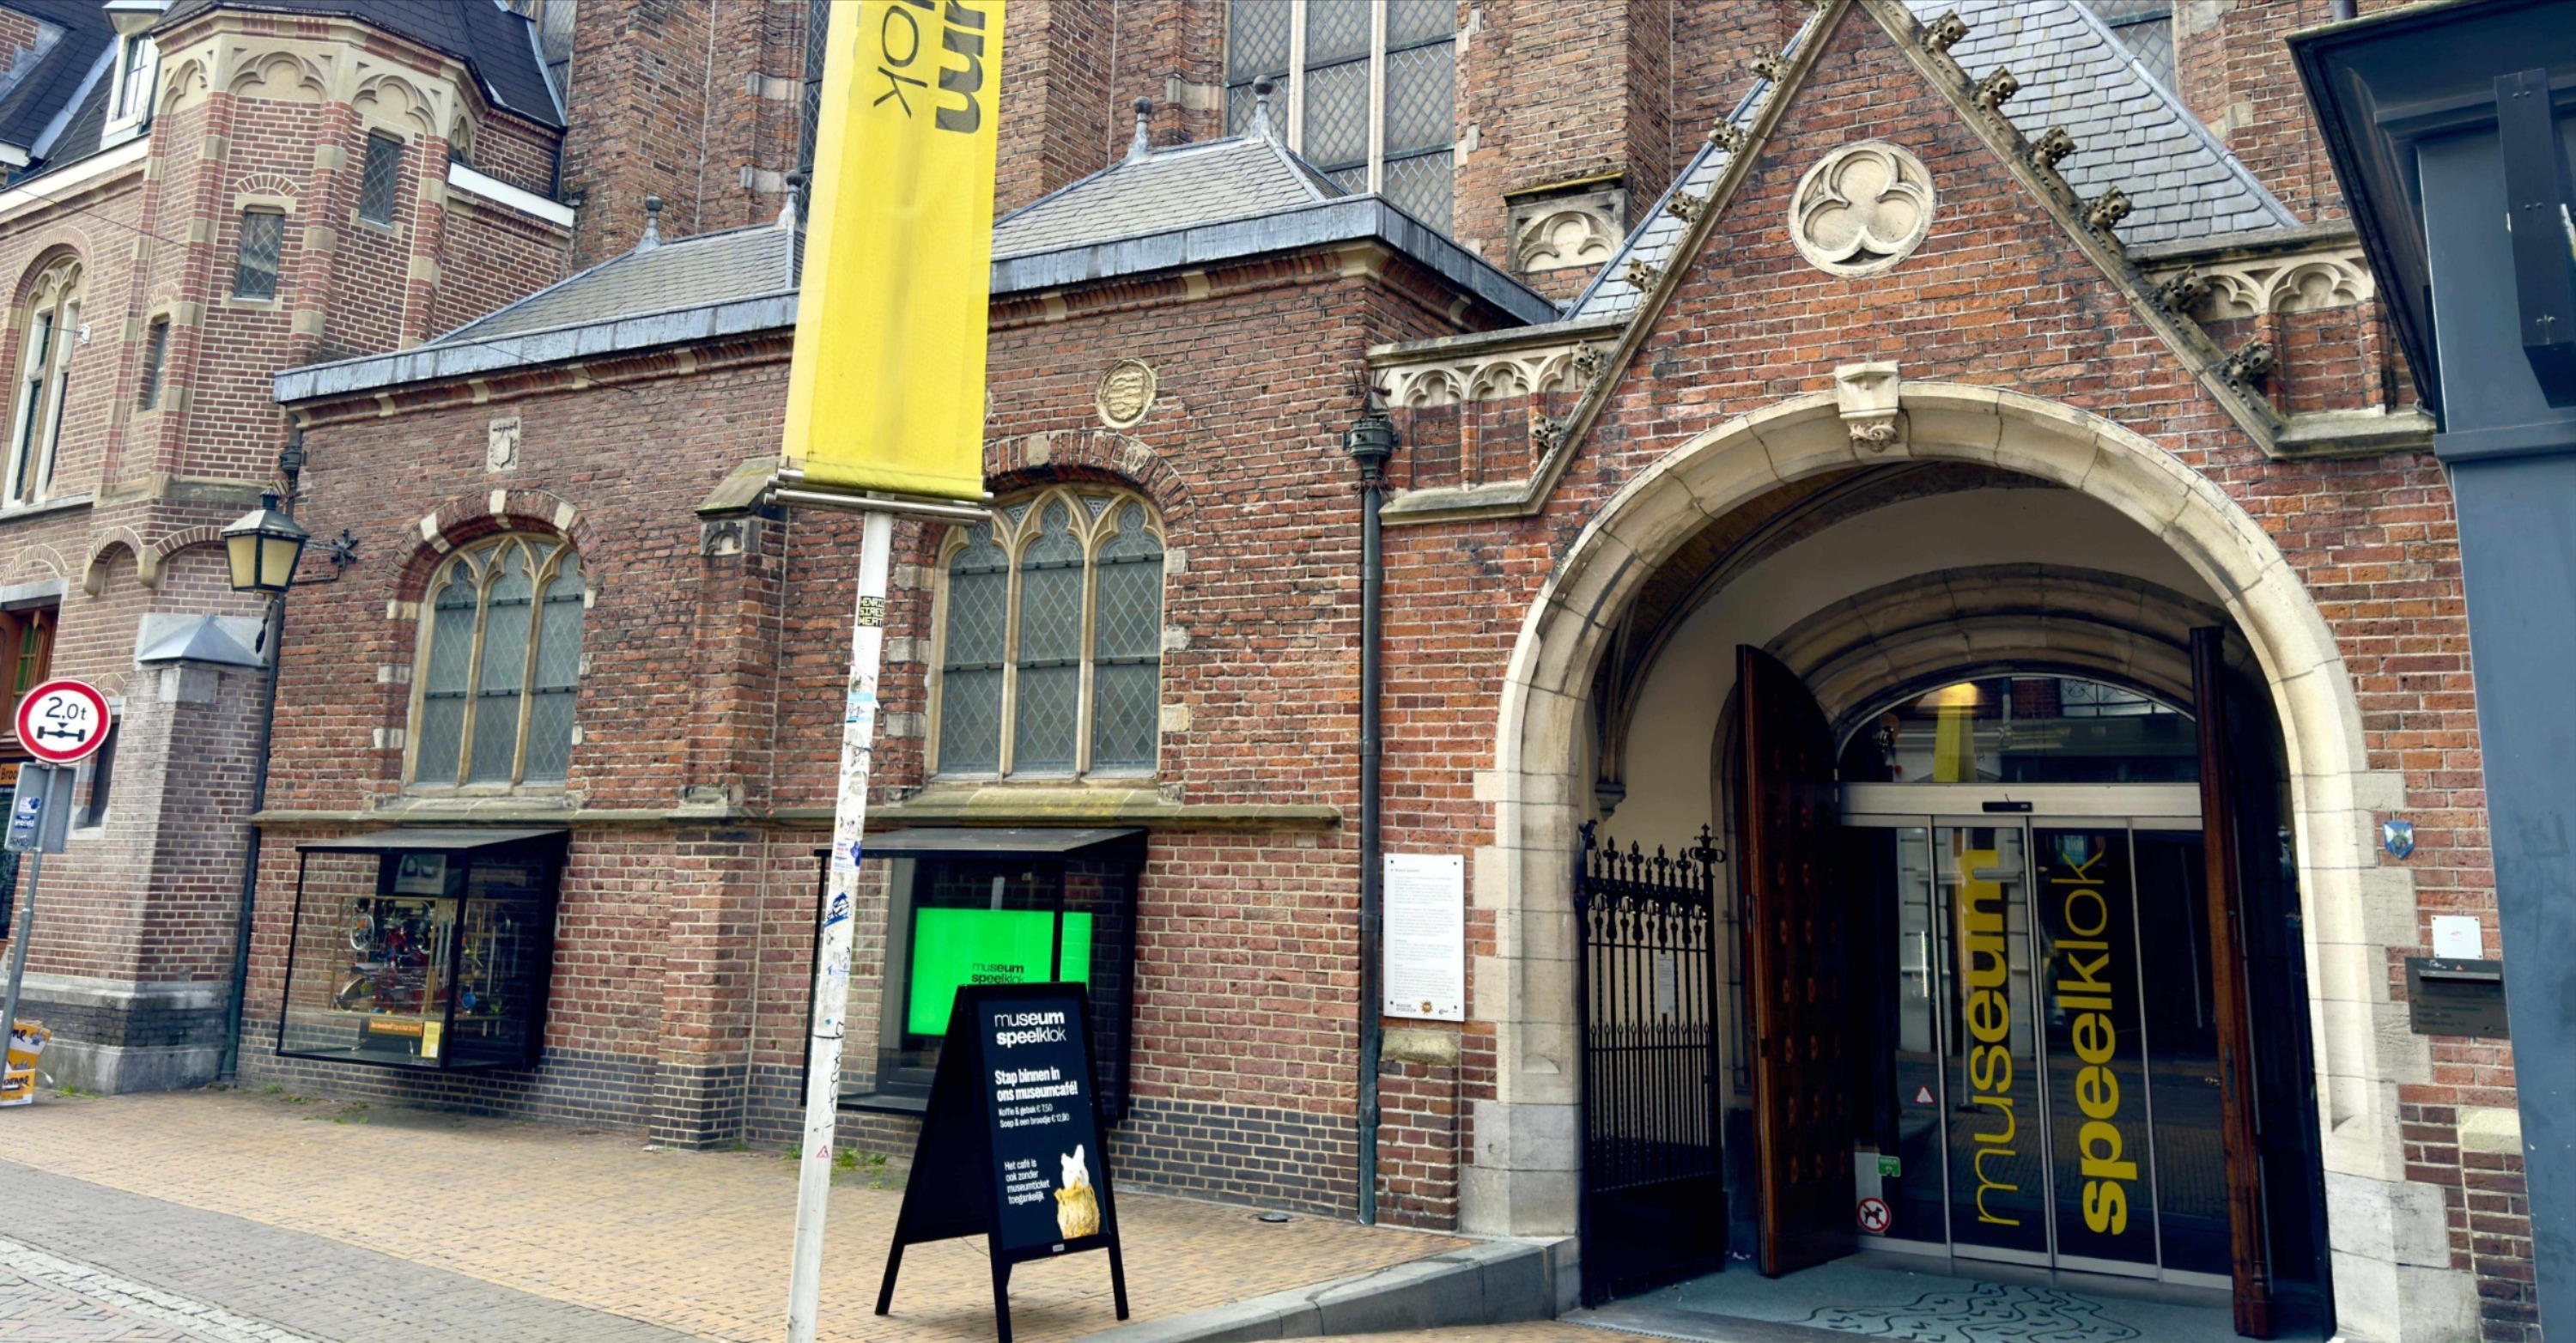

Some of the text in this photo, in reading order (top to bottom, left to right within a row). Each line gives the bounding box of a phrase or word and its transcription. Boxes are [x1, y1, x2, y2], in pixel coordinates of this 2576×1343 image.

[972, 963, 1024, 974] museum
[994, 1012, 1065, 1027] museum
[996, 1026, 1066, 1048] speelklok
[1960, 849, 2020, 1225] museum
[2050, 850, 2138, 1235] speelklok
[994, 1066, 1060, 1086] Stap binnen in
[997, 1080, 1078, 1102] ons museumcafé!
[999, 1106, 1014, 1117] Koffie
[1004, 1158, 1037, 1170] Het café is
[1005, 1170, 1038, 1182] ook zonder
[1006, 1179, 1050, 1194] museumticket
[1008, 1191, 1045, 1205] toegankelijk
